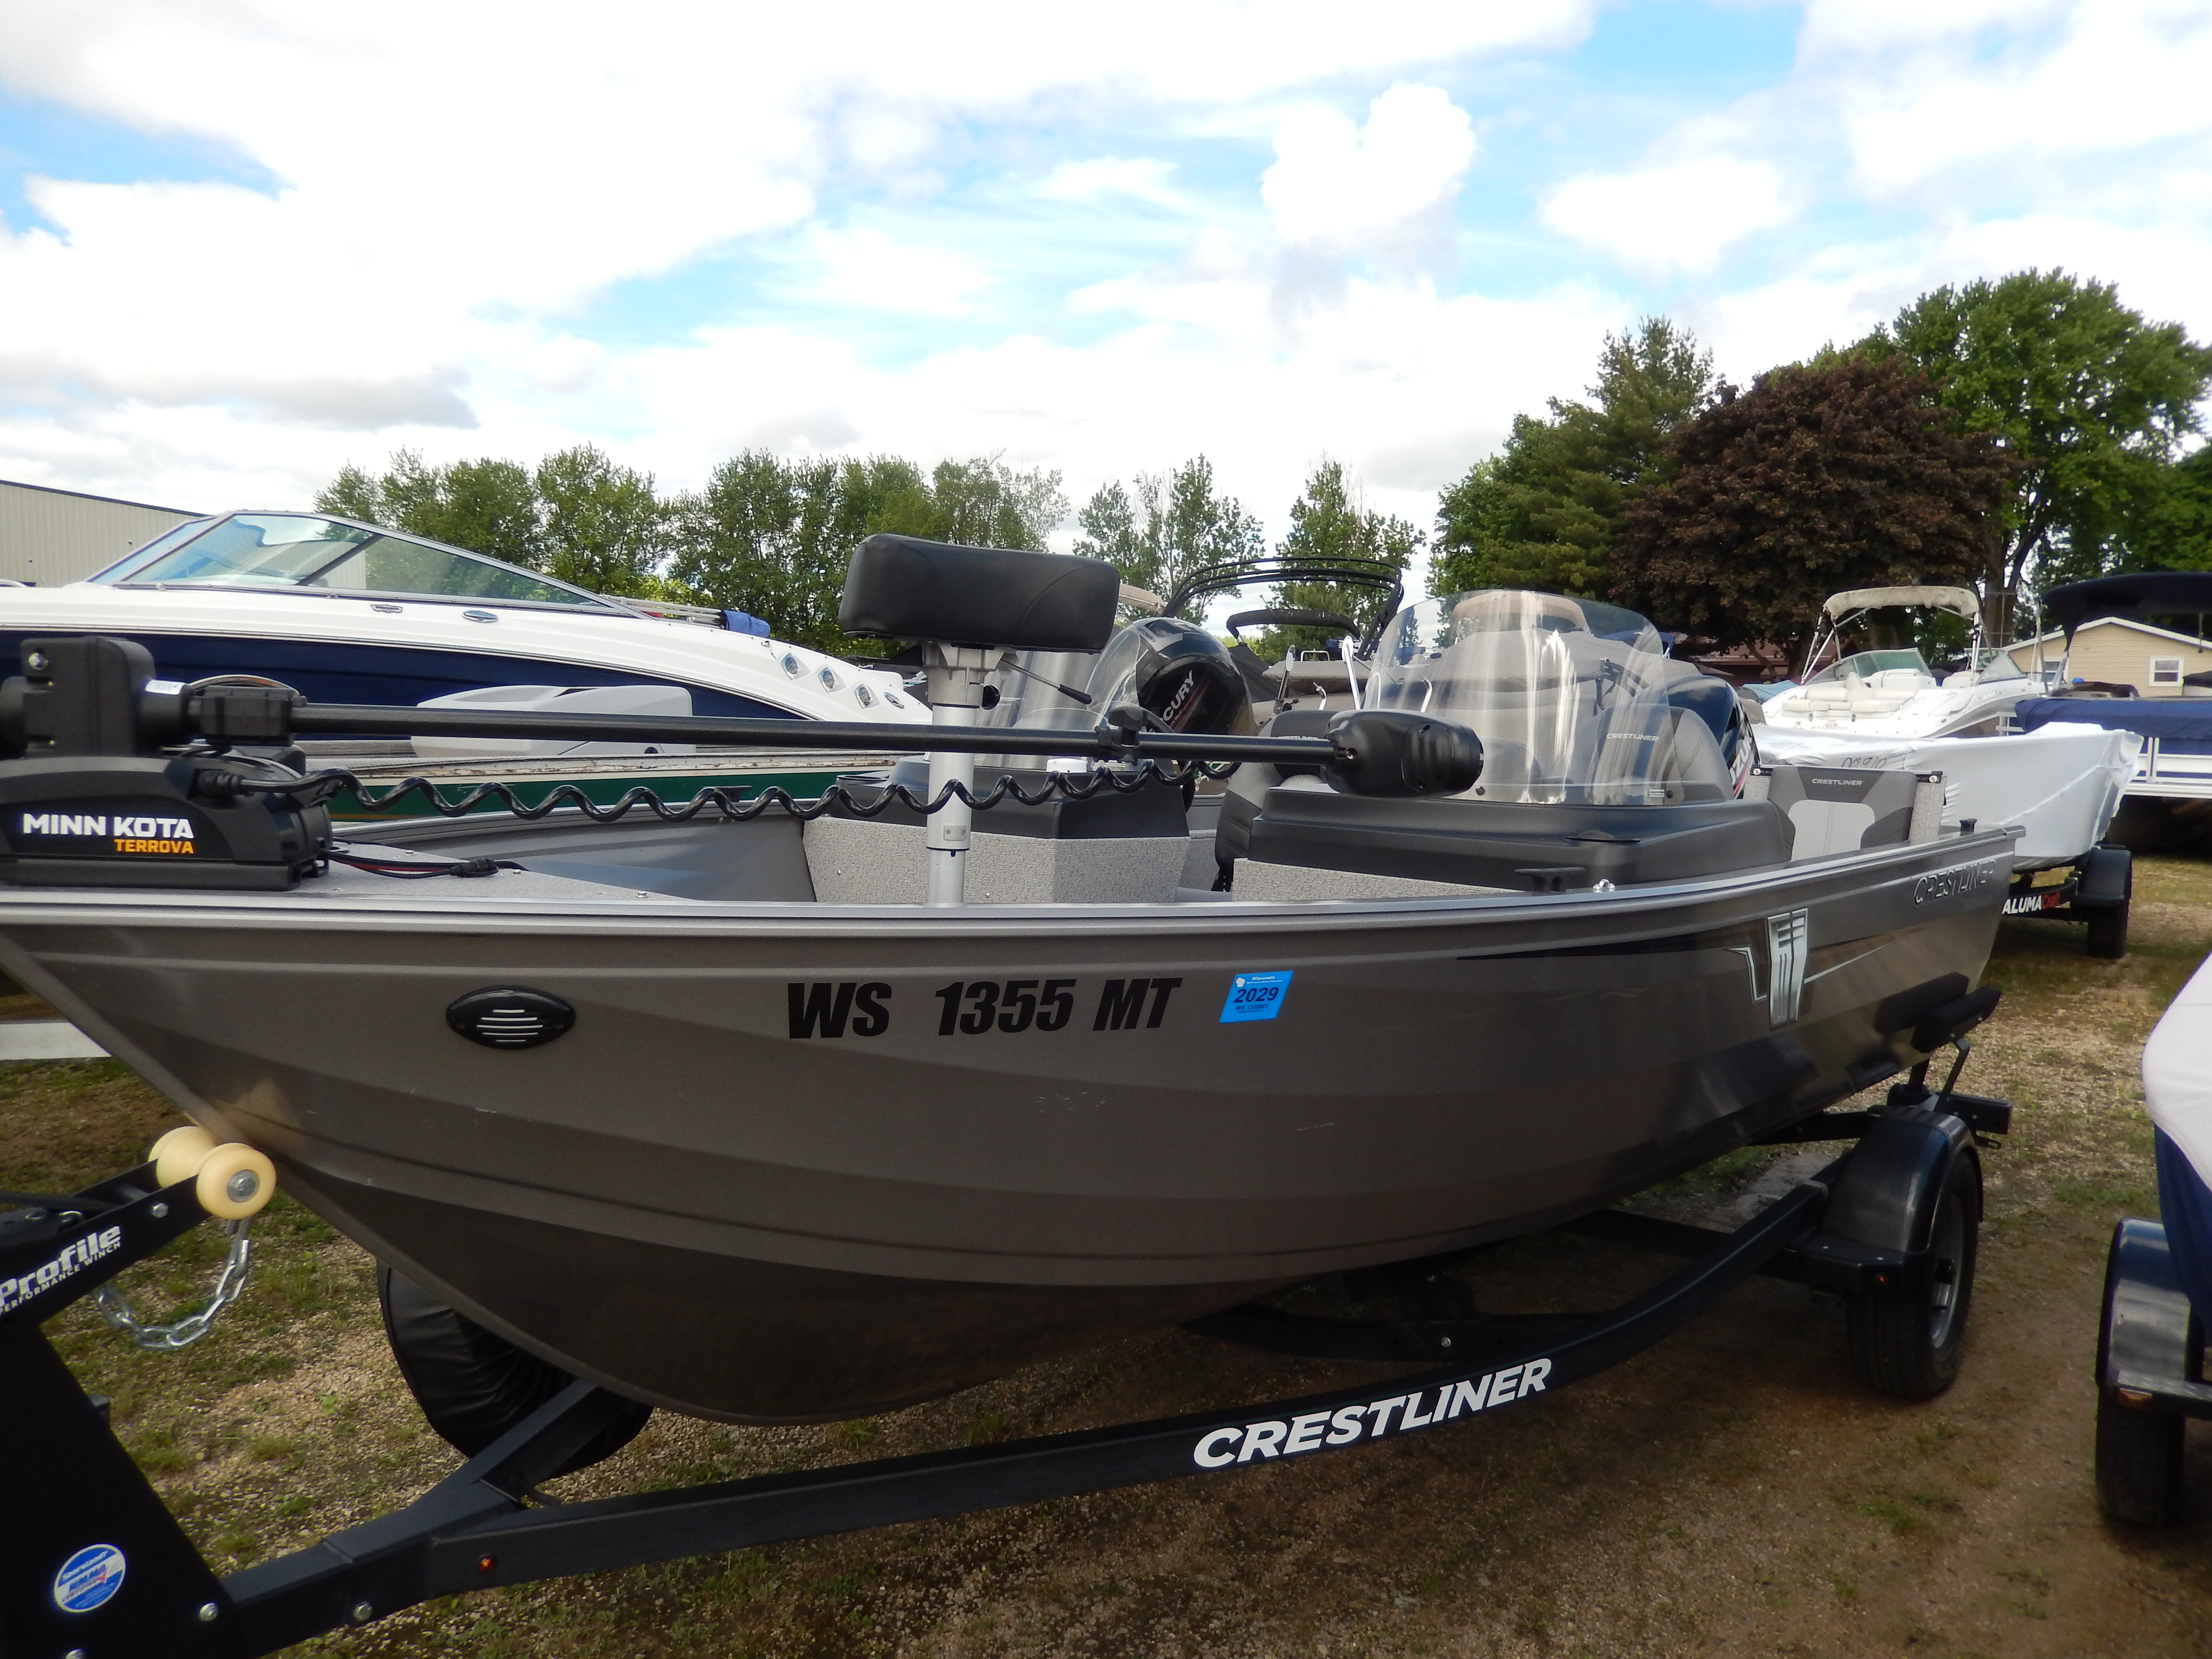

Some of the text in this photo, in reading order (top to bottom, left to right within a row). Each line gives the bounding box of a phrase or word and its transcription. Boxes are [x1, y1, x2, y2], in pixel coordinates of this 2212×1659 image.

[1606, 733, 1659, 741] CRESTLINER
[23, 813, 194, 839] MINN KOTA
[113, 839, 194, 854] TERROVA
[1914, 859, 1996, 907] CRESTLINER
[787, 977, 1183, 1039] WS 1355 MT
[1233, 987, 1279, 1003] 2029
[0, 1226, 121, 1307] Profile
[84, 1241, 121, 1266] WINCH
[1194, 1358, 1551, 1468] CRESTLINER
